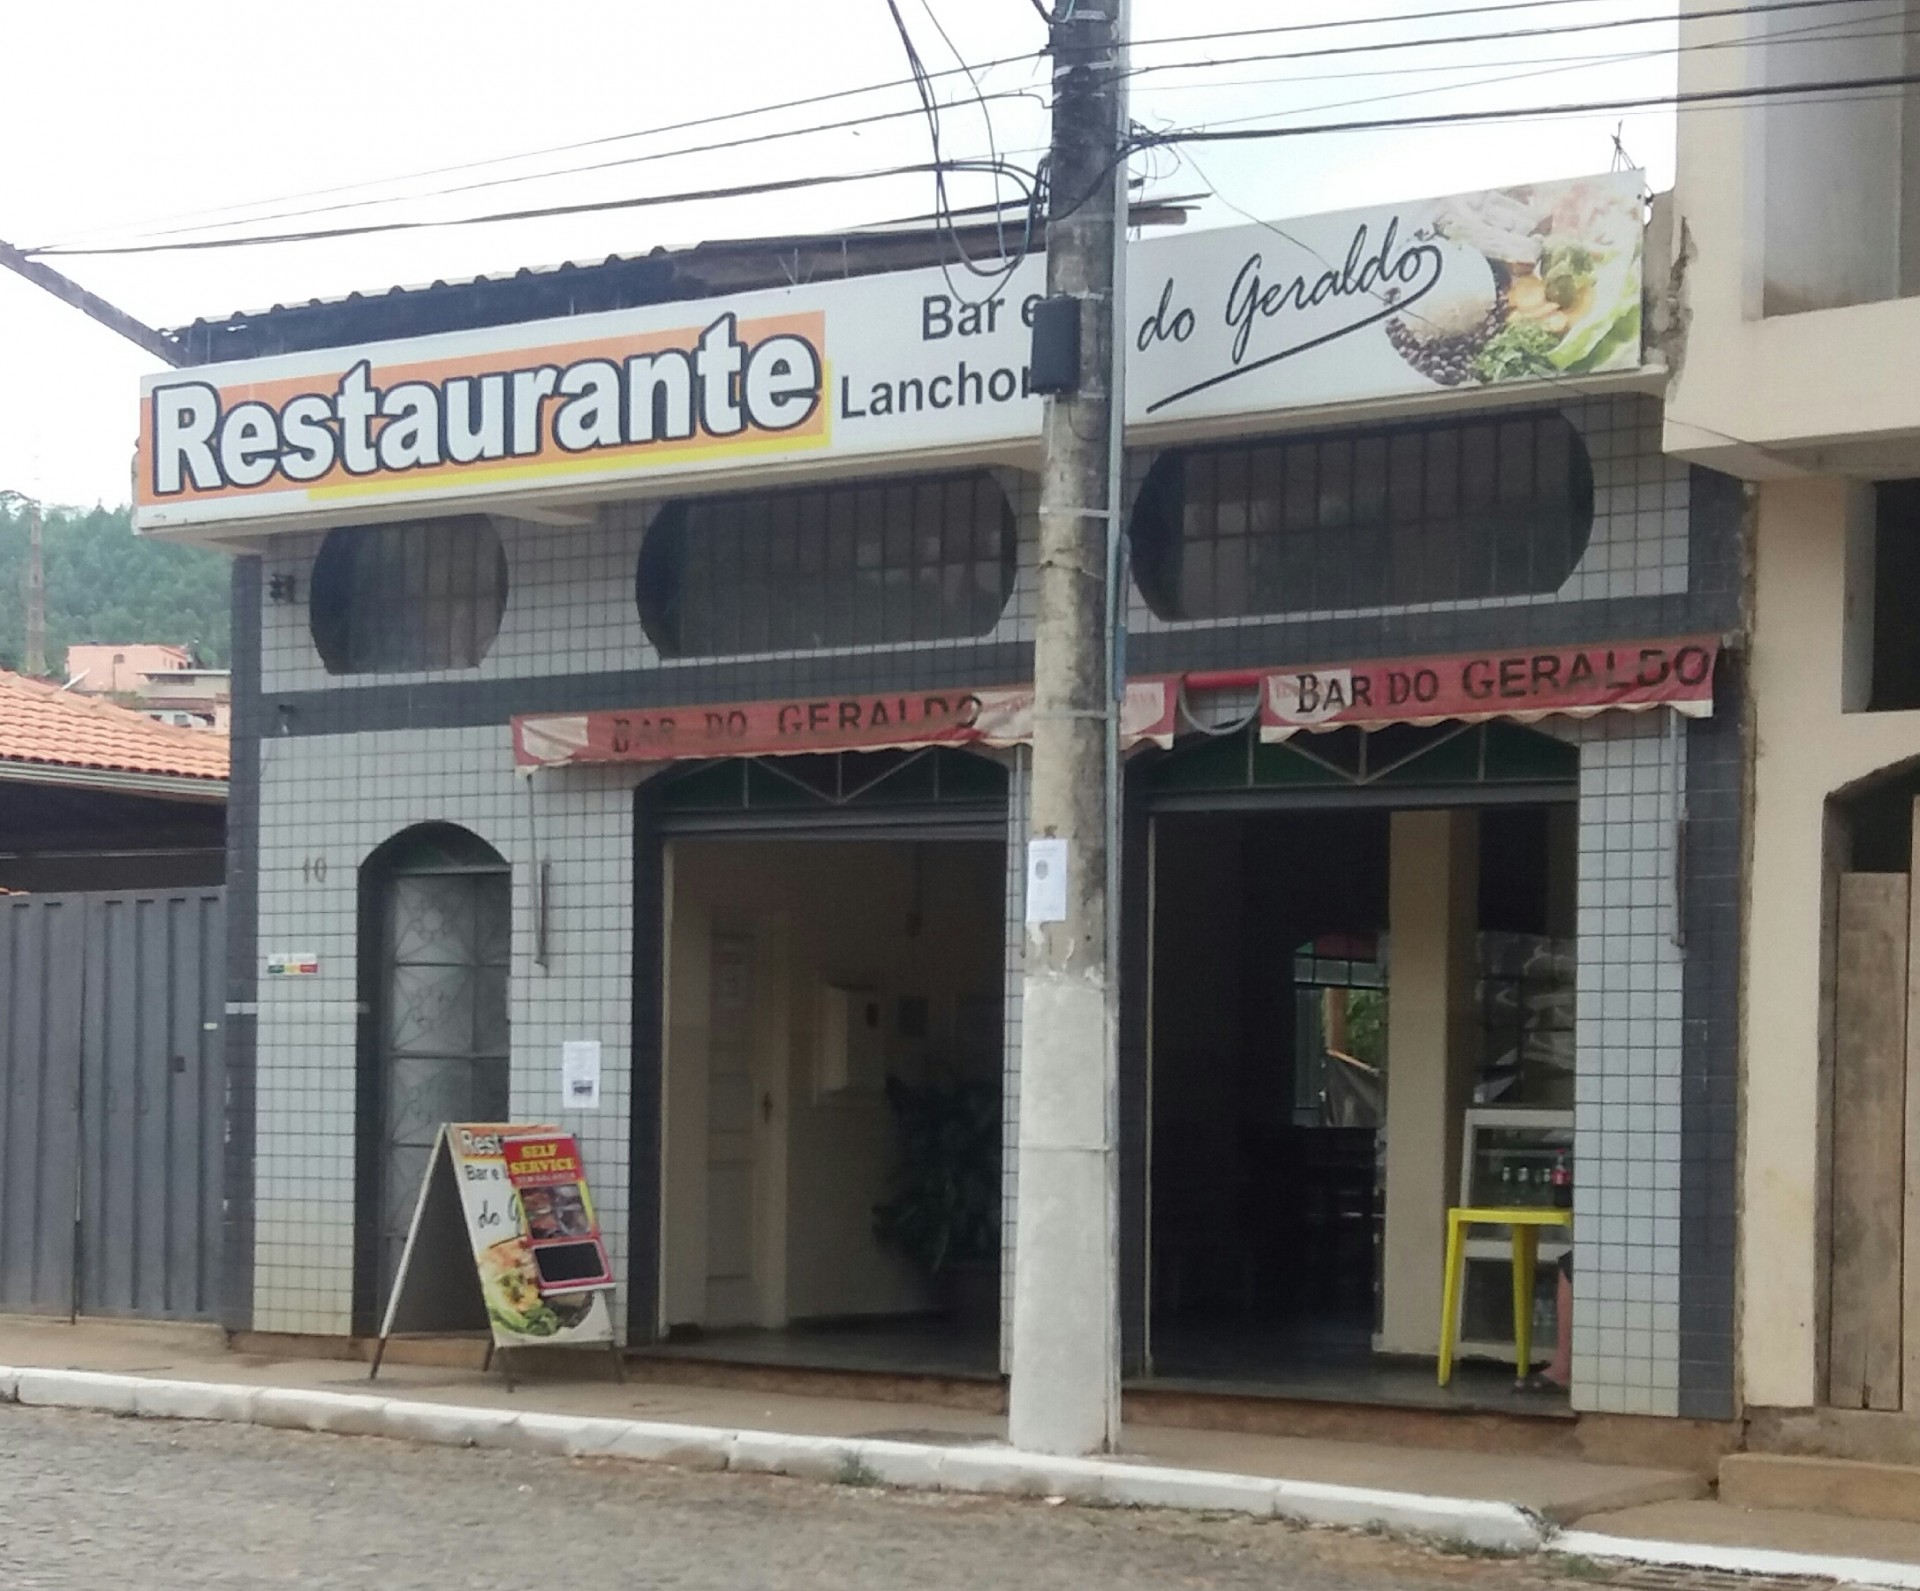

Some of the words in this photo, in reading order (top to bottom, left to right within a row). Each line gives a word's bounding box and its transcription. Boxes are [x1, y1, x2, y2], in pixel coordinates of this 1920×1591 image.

[921, 293, 1006, 342] Bar
[1136, 277, 1196, 353] do
[1224, 215, 1443, 366] Geraldo
[151, 312, 822, 496] Restaurante
[1295, 672, 1373, 715] BAR
[1387, 668, 1440, 705] DO
[1461, 644, 1710, 700] GERALDO
[509, 1157, 576, 1176] SERVICE
